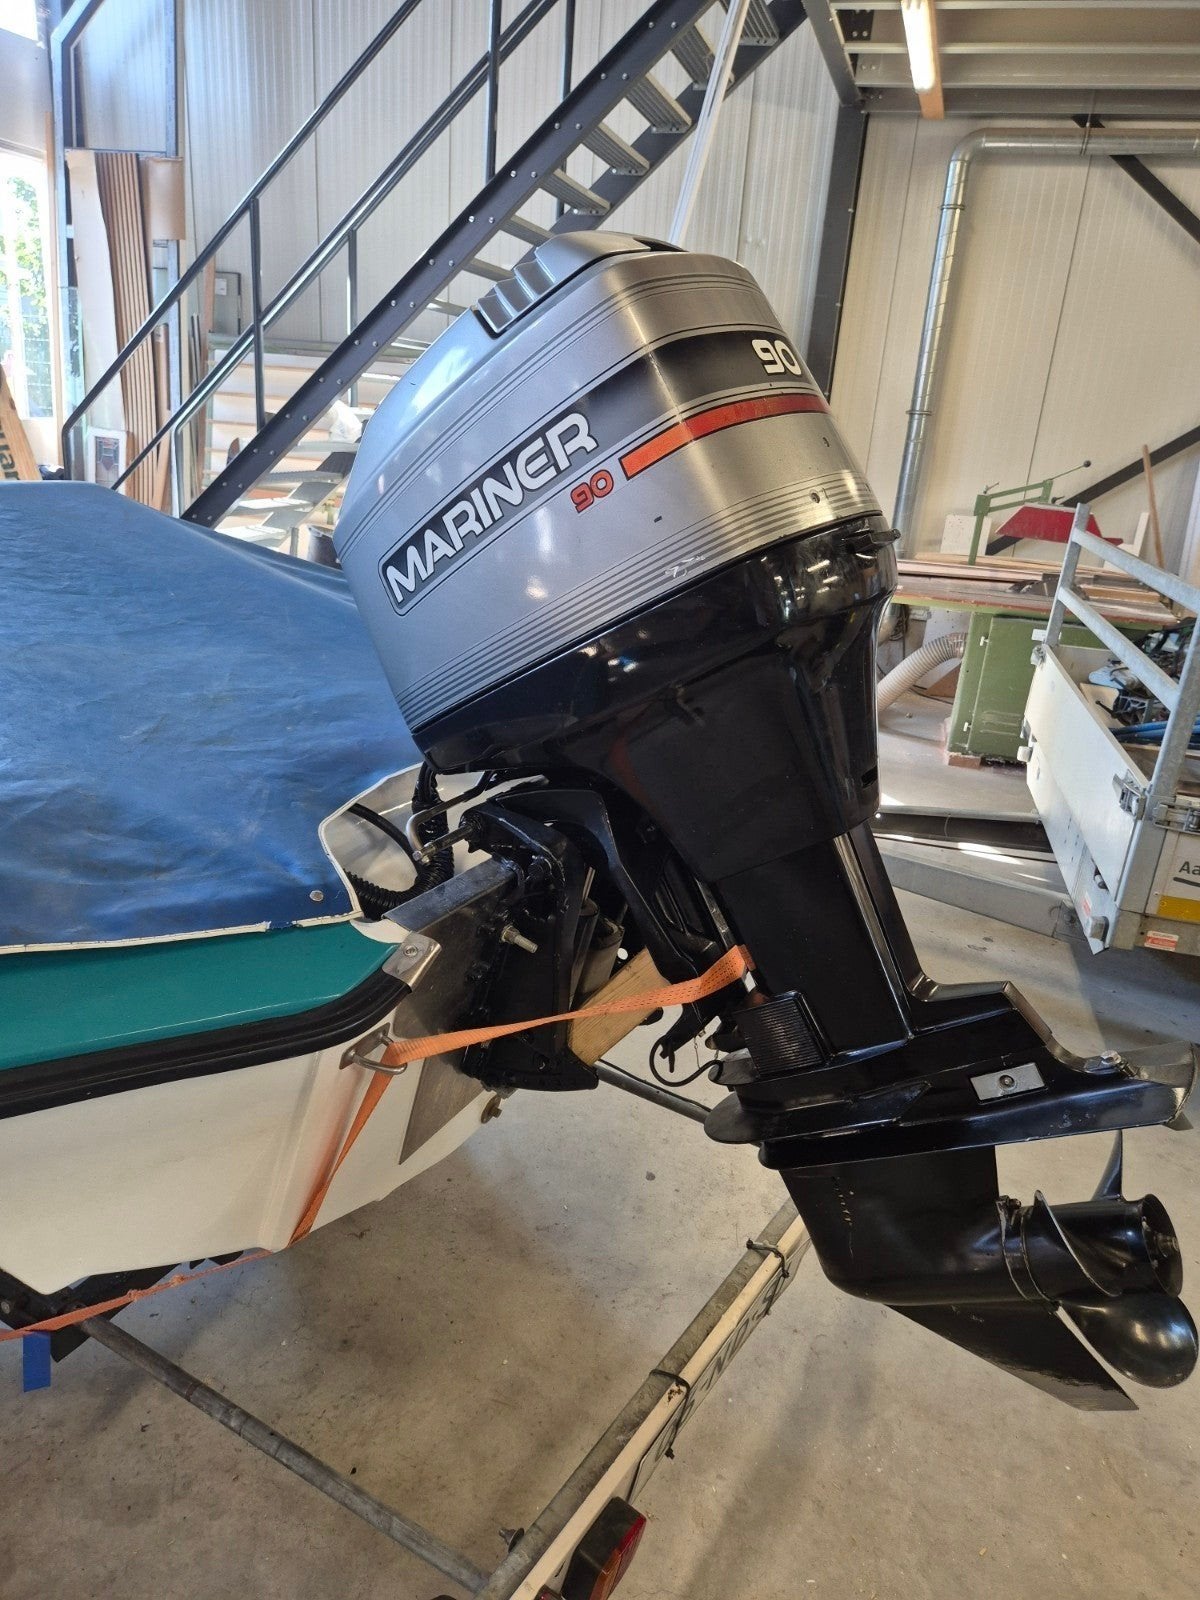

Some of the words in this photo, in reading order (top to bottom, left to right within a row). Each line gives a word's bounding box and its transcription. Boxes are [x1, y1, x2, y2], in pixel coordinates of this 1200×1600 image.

[751, 339, 802, 375] 90
[385, 411, 599, 603] MARINER
[570, 469, 614, 513] 90
